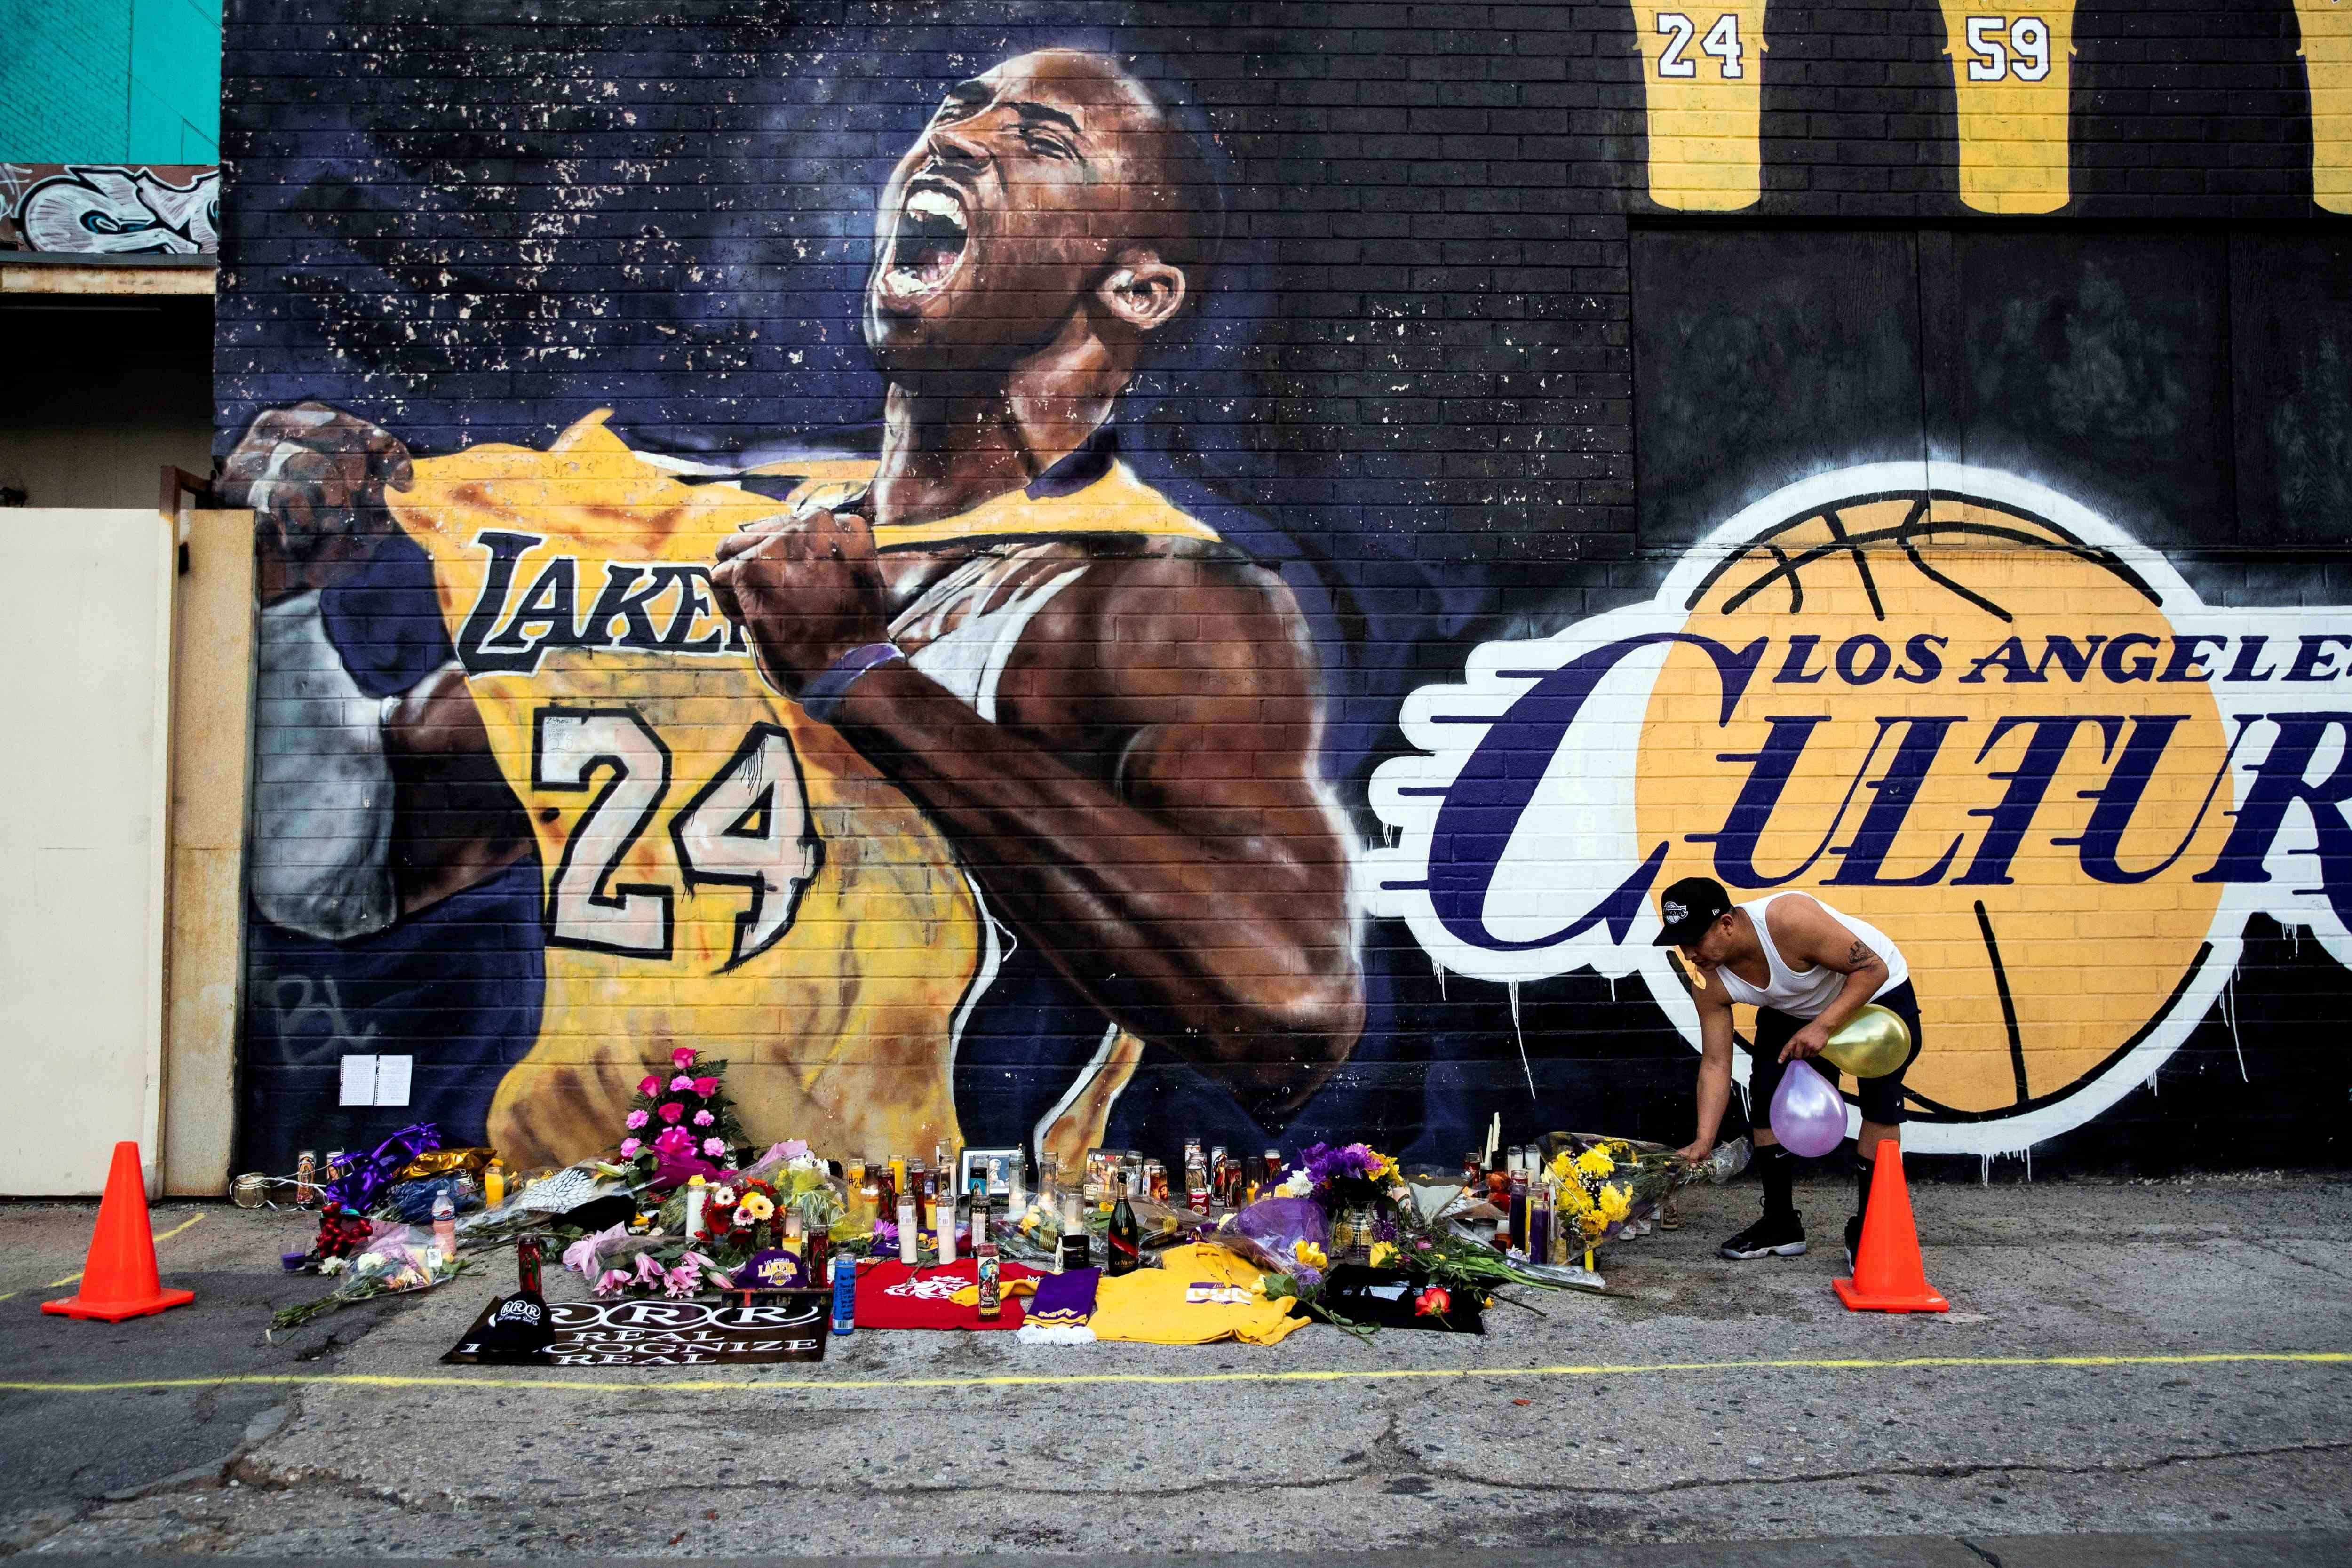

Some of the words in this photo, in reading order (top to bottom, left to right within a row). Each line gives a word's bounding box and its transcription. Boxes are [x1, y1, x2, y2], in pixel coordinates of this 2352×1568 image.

[1657, 12, 1743, 79] 24
[1965, 16, 2051, 82] 59
[456, 527, 753, 681] LAKE
[1772, 633, 1948, 685] LOS
[1959, 633, 2352, 684] ANGELE
[531, 706, 826, 975] 24
[848, 1173, 864, 1188] #24
[758, 1262, 798, 1277] LAKERS
[556, 1353, 716, 1365] REAL
[569, 1330, 725, 1342] REAL
